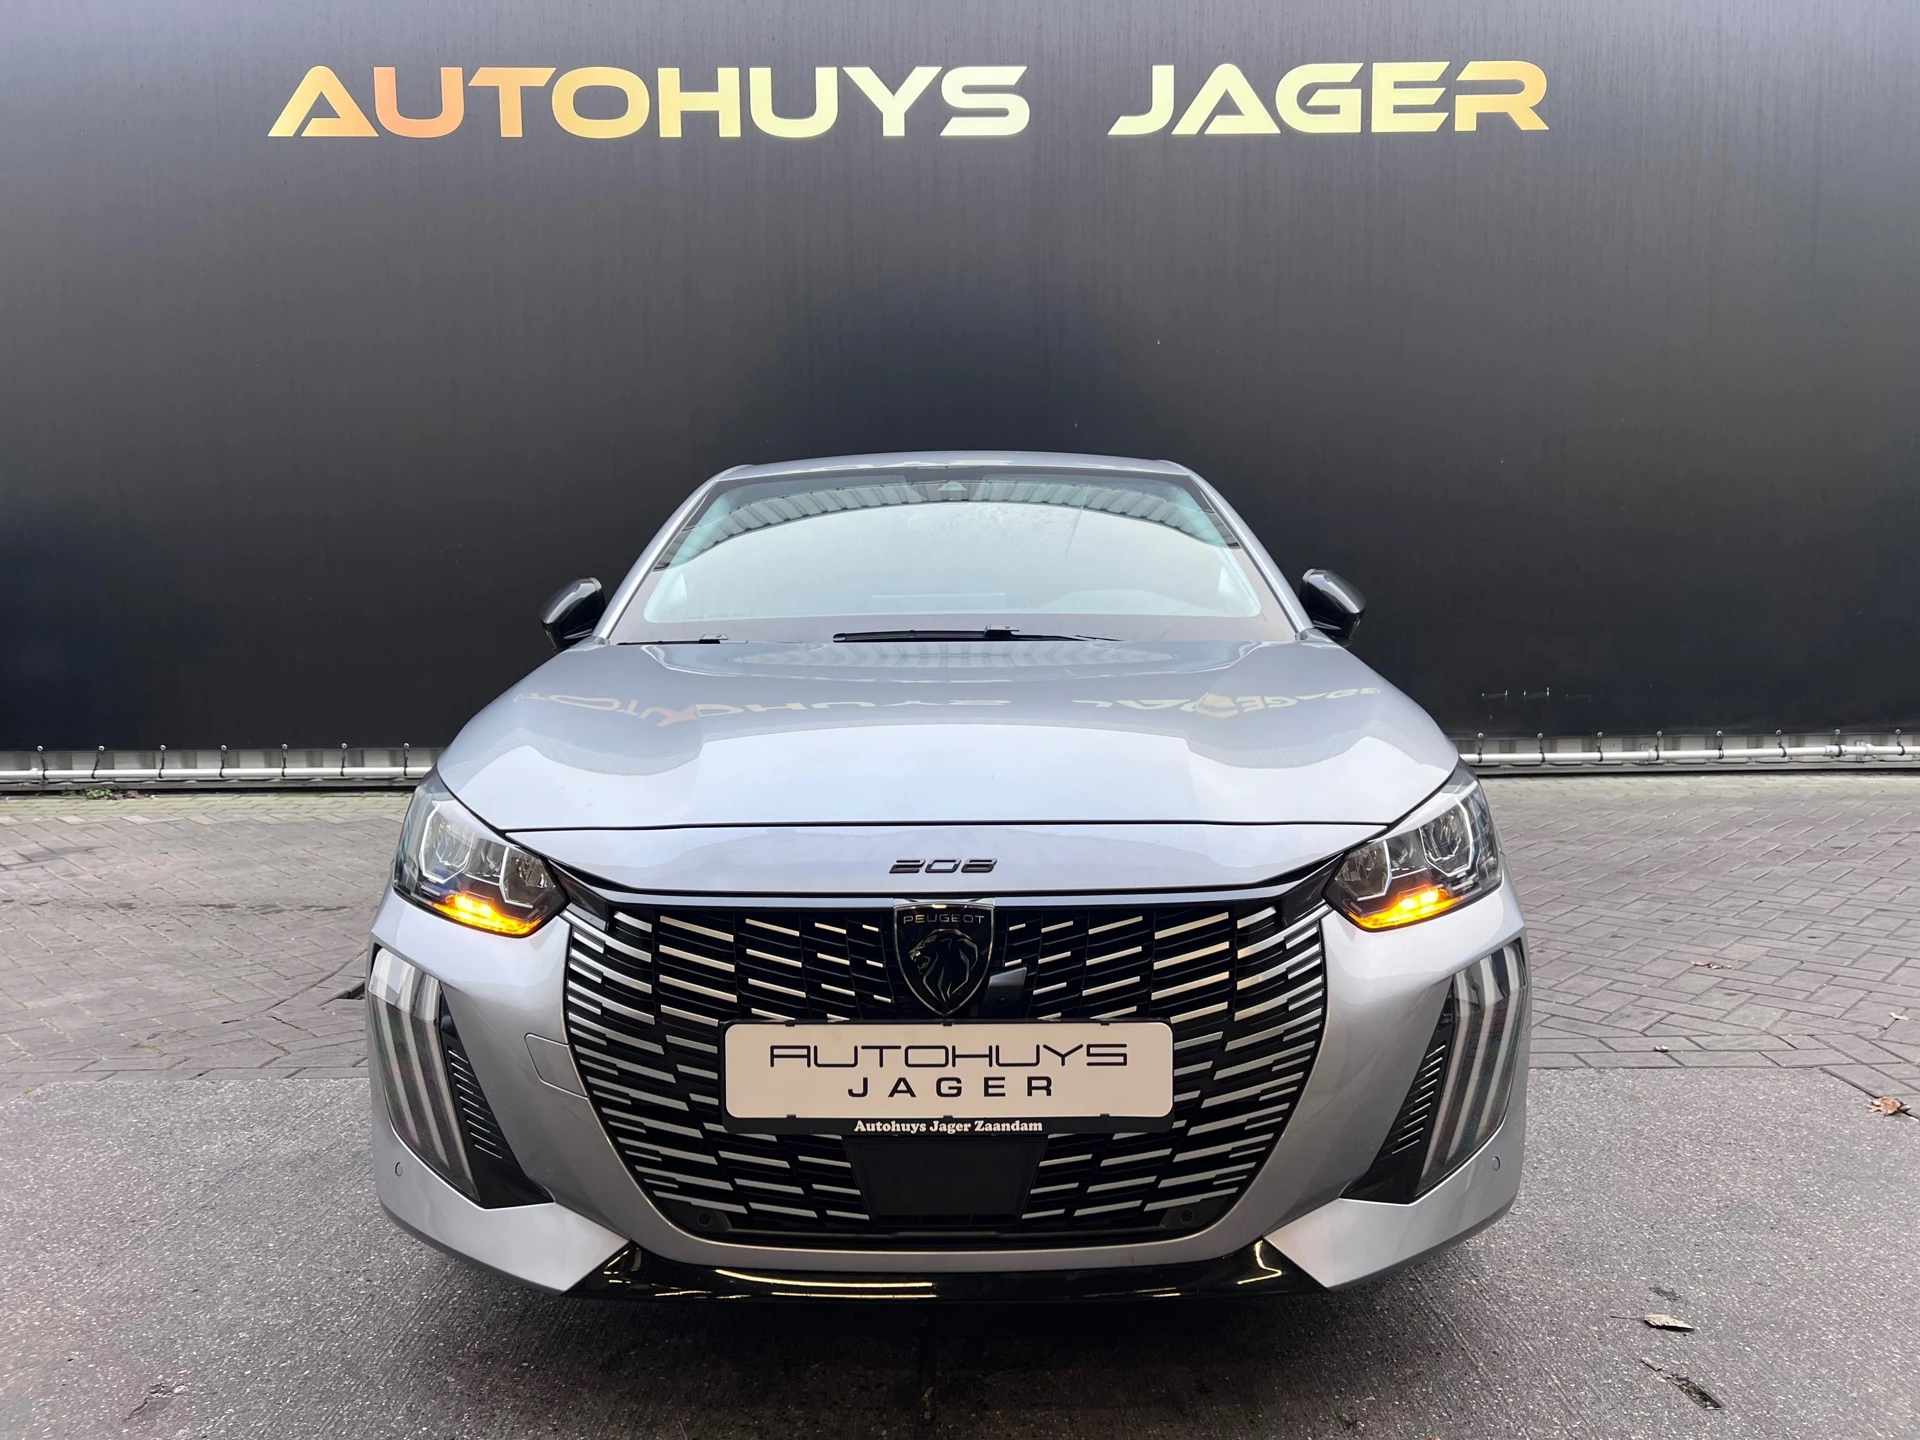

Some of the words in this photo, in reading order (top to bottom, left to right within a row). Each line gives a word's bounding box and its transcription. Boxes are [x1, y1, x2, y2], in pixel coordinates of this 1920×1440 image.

[268, 65, 1030, 138] AUTOHUYS
[1107, 60, 1550, 135] JAGER
[889, 858, 997, 874] 208
[903, 914, 985, 925] PEUGEOT
[770, 1043, 1128, 1068] AUTOHUYS
[847, 1076, 1053, 1098] JAGER
[854, 1120, 927, 1133] Autohuys
[929, 1120, 972, 1133] Jager
[974, 1119, 1043, 1132] Zaandam
